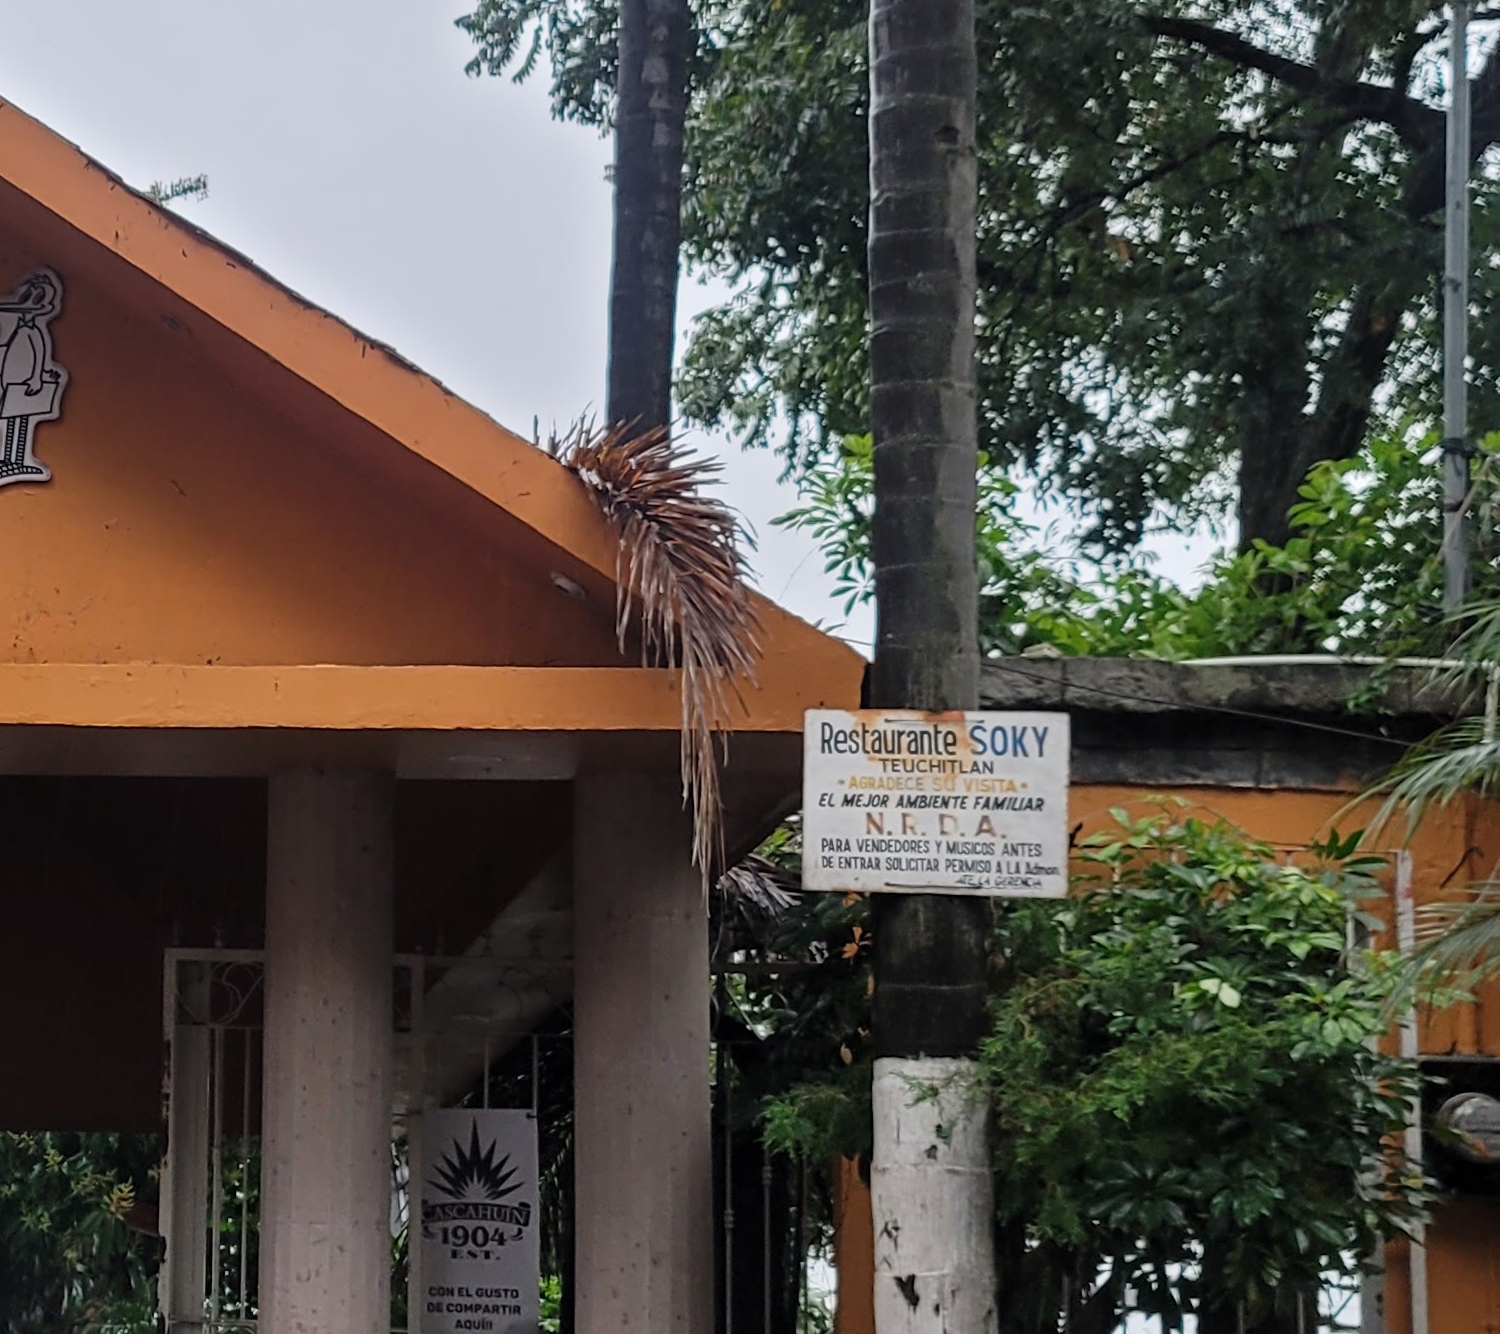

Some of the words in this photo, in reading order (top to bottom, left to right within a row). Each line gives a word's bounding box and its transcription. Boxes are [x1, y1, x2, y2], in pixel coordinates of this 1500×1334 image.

[820, 721, 958, 756] Restaurante
[969, 724, 1049, 758] SOKY
[878, 758, 995, 775] TEUCHITLAN
[932, 777, 956, 792] SU
[818, 792, 836, 808] EL
[840, 793, 890, 808] MEJOR
[896, 794, 969, 810] AMBIENTE
[973, 796, 1045, 812] FAMILIAR
[821, 837, 852, 853] PARA
[856, 838, 930, 854] VENDEDORES
[935, 840, 943, 855] Y
[946, 840, 996, 856] MUSICOS
[1001, 842, 1043, 858] ANTES
[821, 855, 834, 869] DE
[838, 856, 881, 871] ENTRAR
[885, 857, 940, 872] SOLICITAR
[945, 858, 991, 873] PERMISO
[996, 861, 1003, 874] A
[1007, 861, 1021, 875] LA
[441, 1225, 508, 1248] 1904
[450, 1249, 501, 1260] EST.
[428, 1286, 455, 1298] CON
[457, 1287, 473, 1298] EL
[475, 1288, 520, 1299] GUSTO
[426, 1302, 444, 1313] DE
[446, 1302, 522, 1316] COMPARTIR
